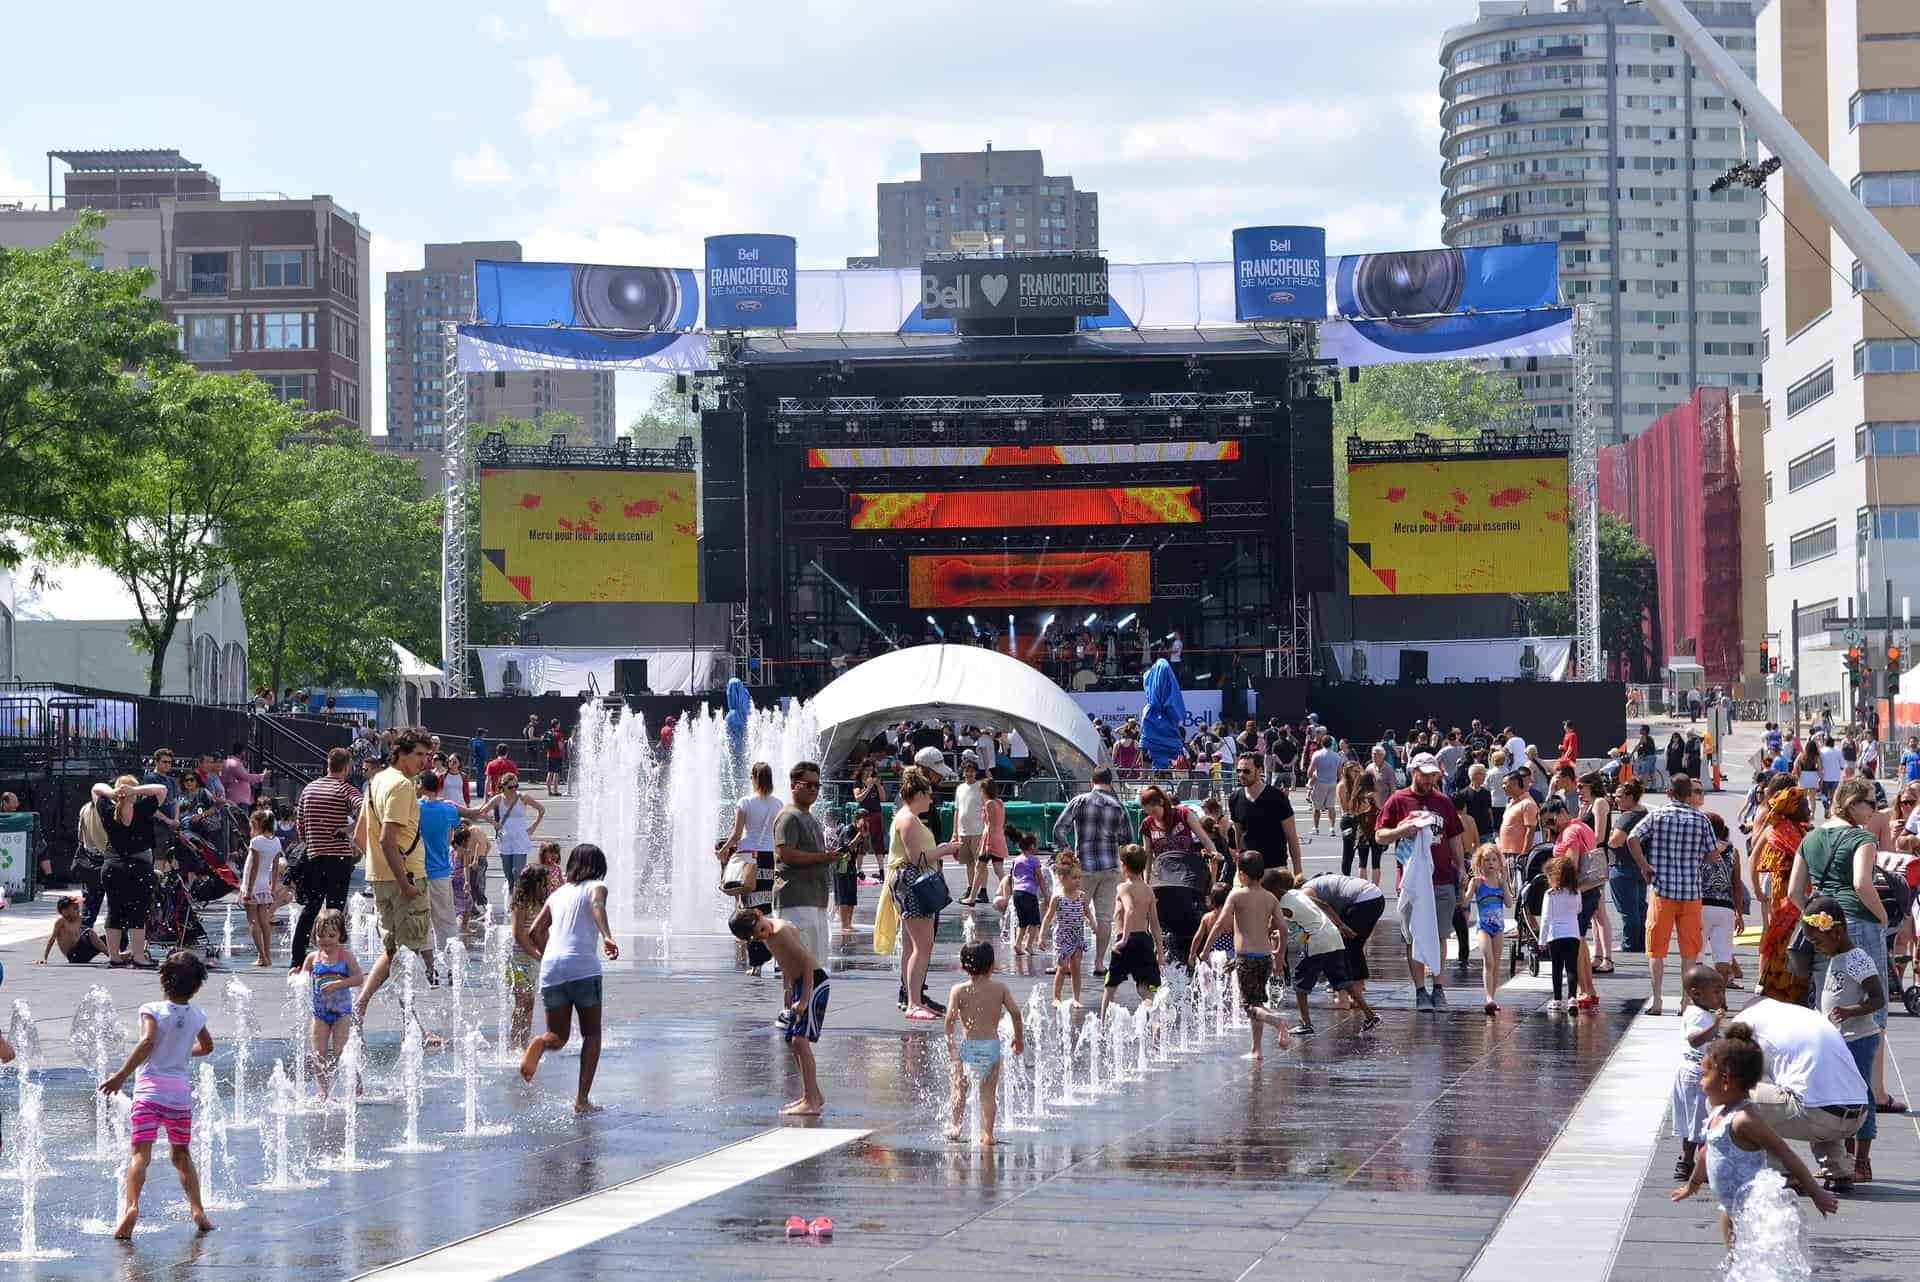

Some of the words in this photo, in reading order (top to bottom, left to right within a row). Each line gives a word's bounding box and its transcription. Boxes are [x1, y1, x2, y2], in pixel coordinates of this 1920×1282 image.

[1270, 239, 1291, 252] Bell
[738, 248, 759, 261] Bell
[1240, 258, 1321, 278] FRANCOFOLIES
[711, 267, 788, 287] FRANCOFOLIES
[1240, 278, 1256, 288] DE
[1020, 272, 1107, 296] FRANCOFOLIES
[711, 286, 725, 296] DE
[922, 273, 971, 309] Bell
[1020, 296, 1037, 307] DE
[1394, 522, 1418, 533] Merci
[1420, 523, 1437, 534] pour
[529, 529, 553, 541] Merci
[555, 530, 573, 542] pour
[1183, 710, 1212, 727] Bell
